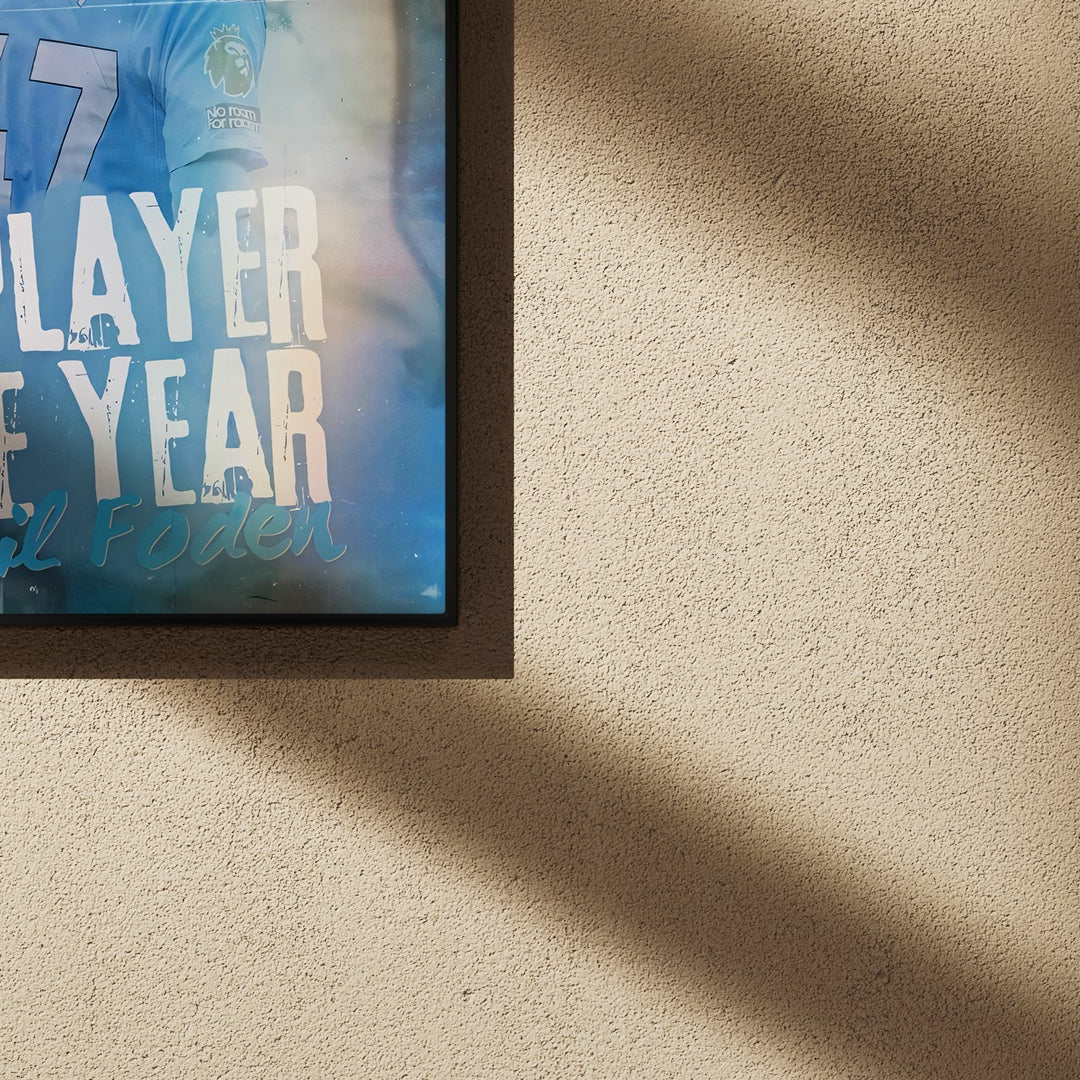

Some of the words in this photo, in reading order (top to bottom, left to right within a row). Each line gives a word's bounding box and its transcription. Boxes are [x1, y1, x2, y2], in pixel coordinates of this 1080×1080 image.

[207, 105, 226, 118] No
[57, 348, 333, 511] YEAR
[90, 491, 348, 571] Foden
